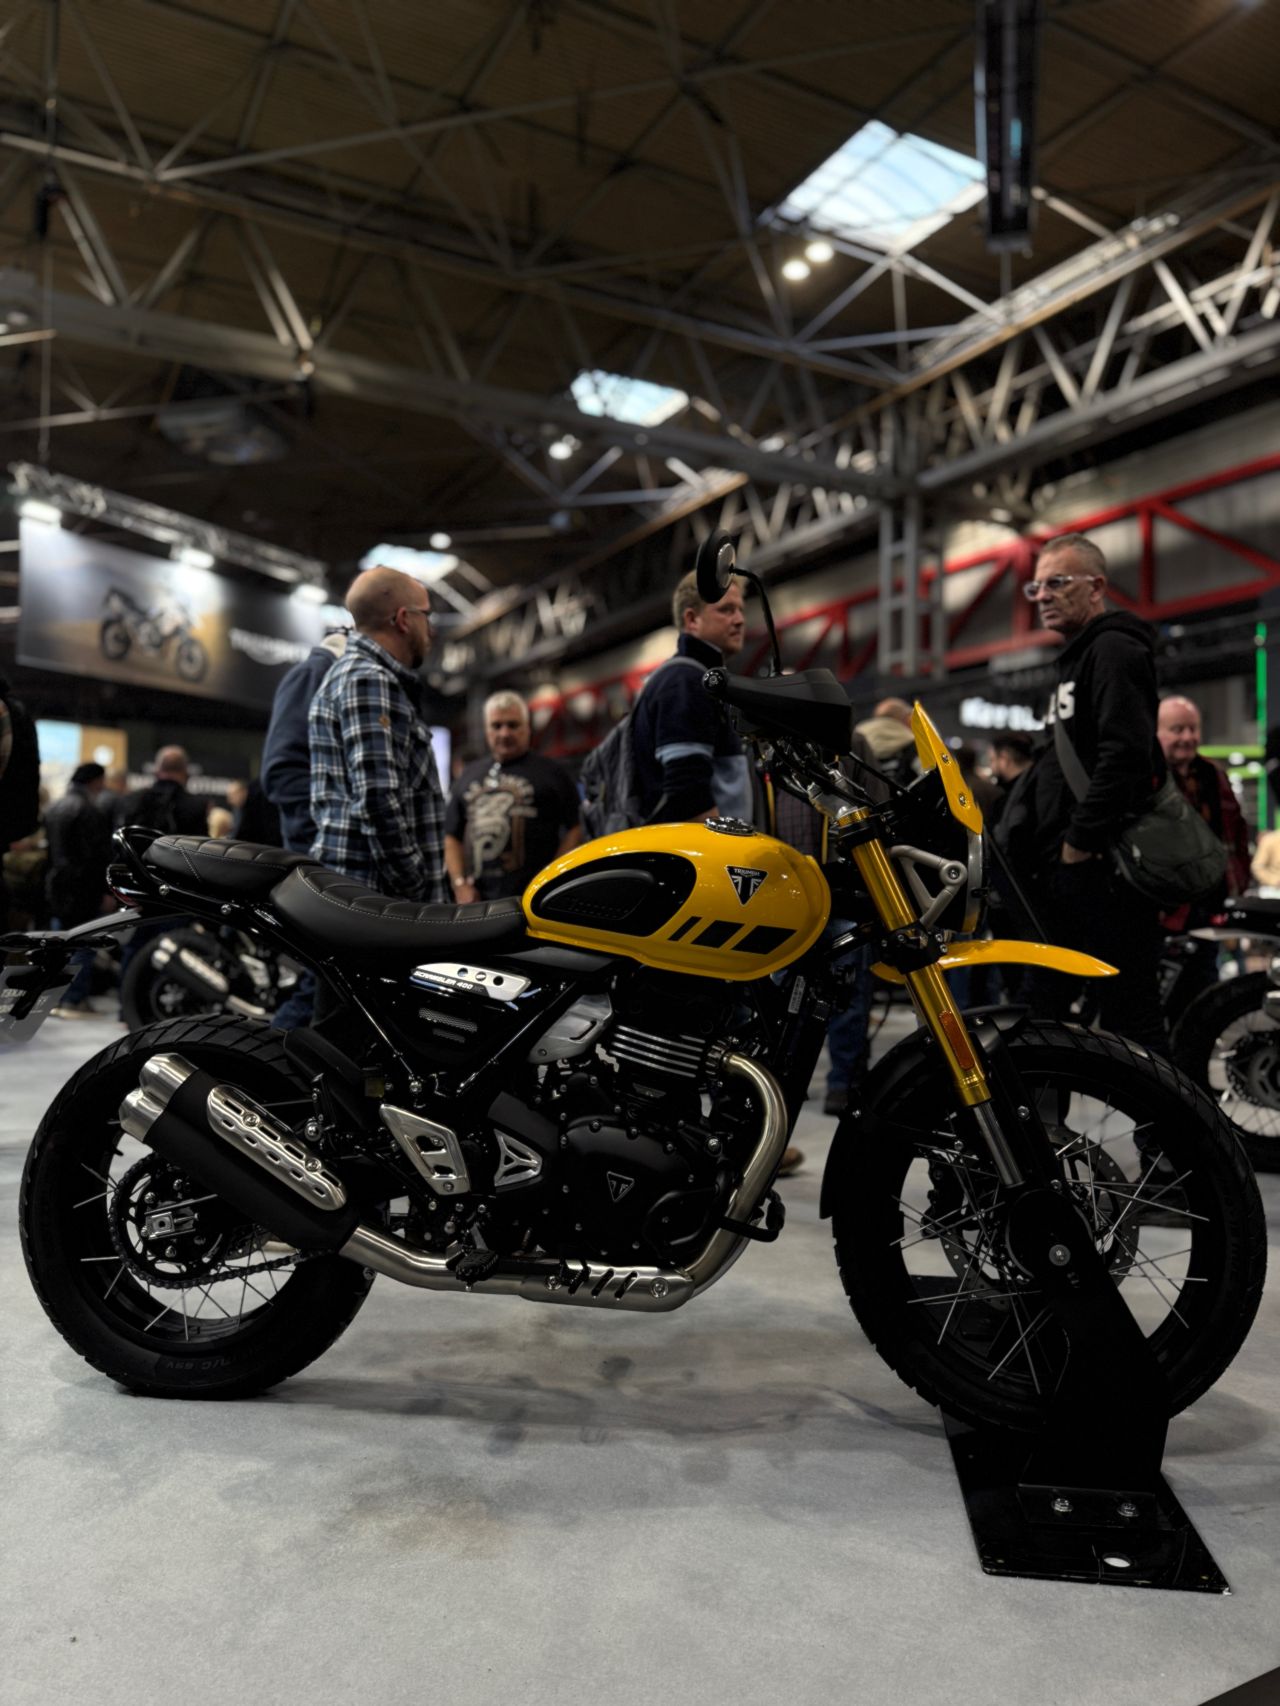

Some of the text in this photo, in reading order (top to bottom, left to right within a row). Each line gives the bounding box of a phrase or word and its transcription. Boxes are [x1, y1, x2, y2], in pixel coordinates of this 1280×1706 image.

[734, 868, 761, 877] TRIUMPH
[412, 970, 456, 986] SCRAMBLER
[456, 981, 474, 990] 400
